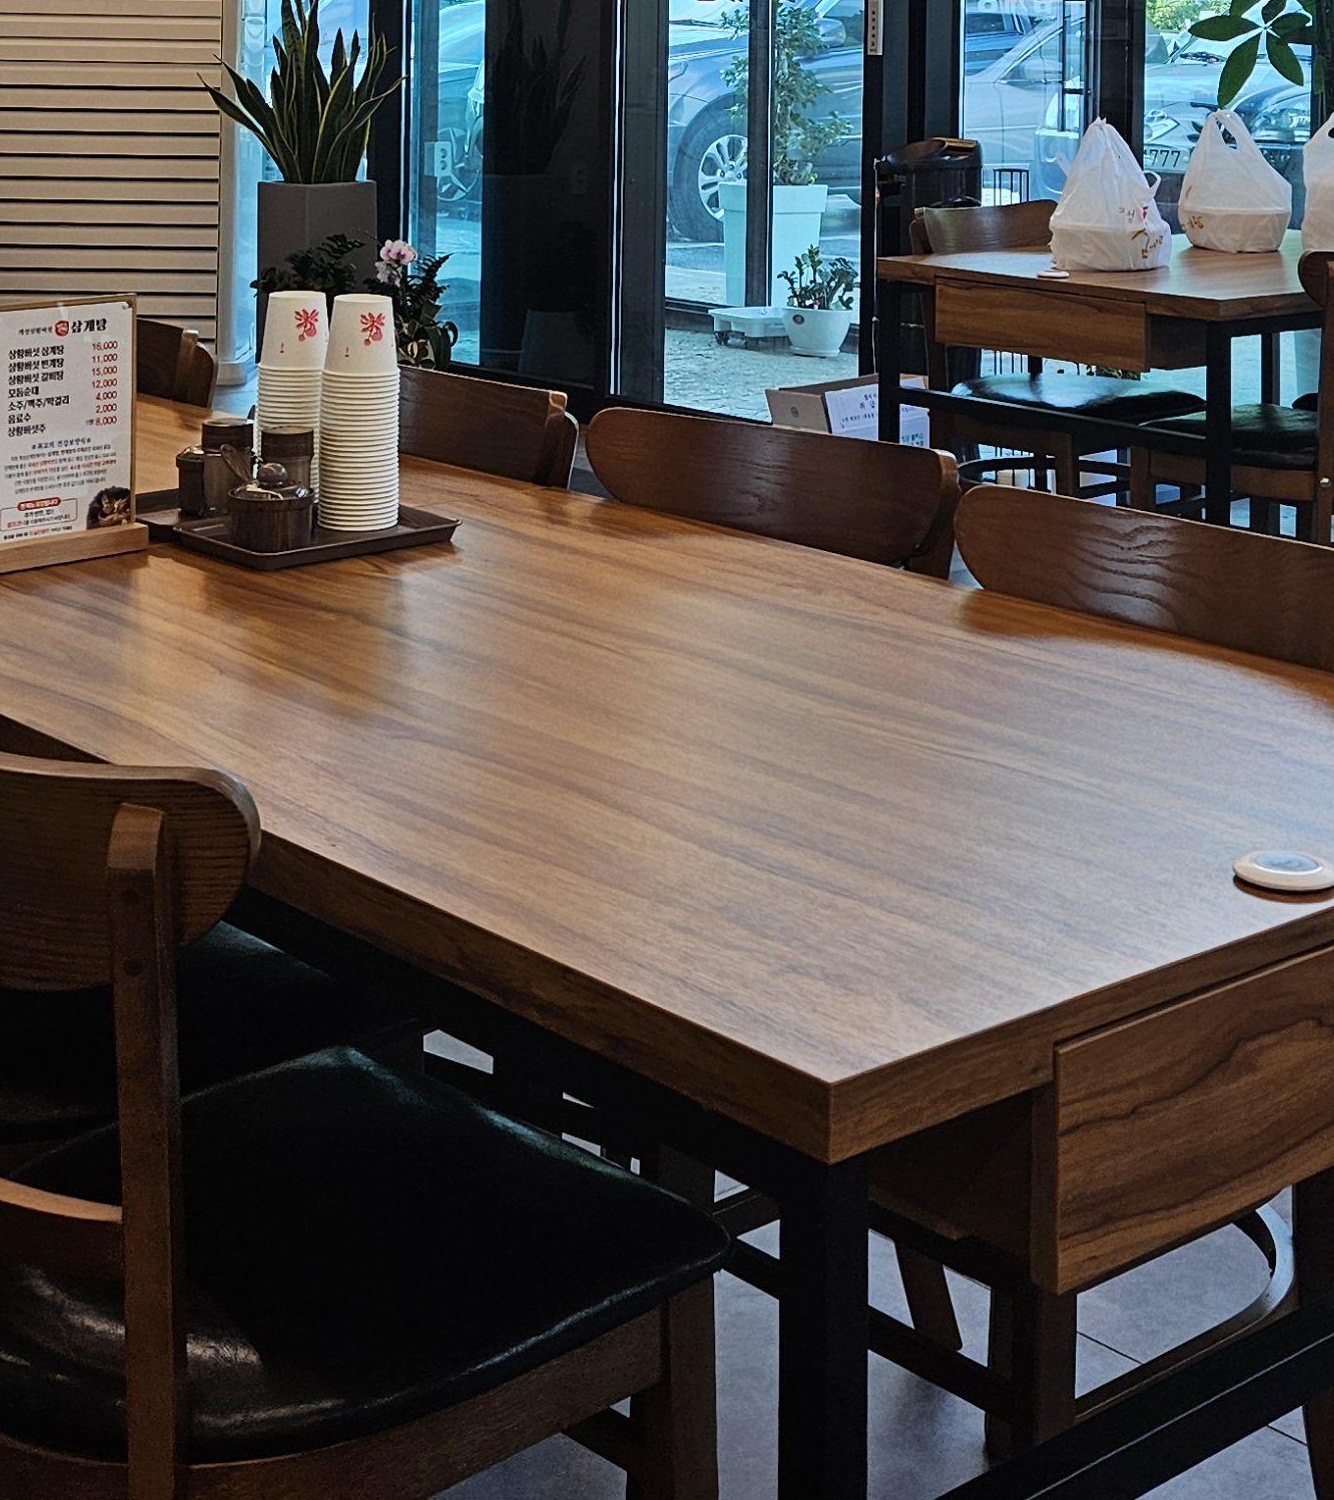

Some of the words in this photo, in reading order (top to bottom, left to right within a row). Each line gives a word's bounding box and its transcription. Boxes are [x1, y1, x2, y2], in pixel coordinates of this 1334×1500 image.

[71, 318, 107, 334] 삼계탕
[92, 340, 118, 351] 16,000
[8, 348, 40, 360] 상황버섯
[92, 353, 118, 364] 11,000
[8, 360, 40, 373] 상황버섯
[92, 365, 118, 376] 15,000
[8, 373, 40, 386] 상황버섯
[92, 378, 117, 389] 12,000
[95, 391, 117, 401] 4,000
[8, 395, 69, 411] 소주/맥주/막걸리
[95, 403, 117, 414] 2,000
[8, 412, 31, 424] 음료수
[95, 416, 117, 426] 8,000
